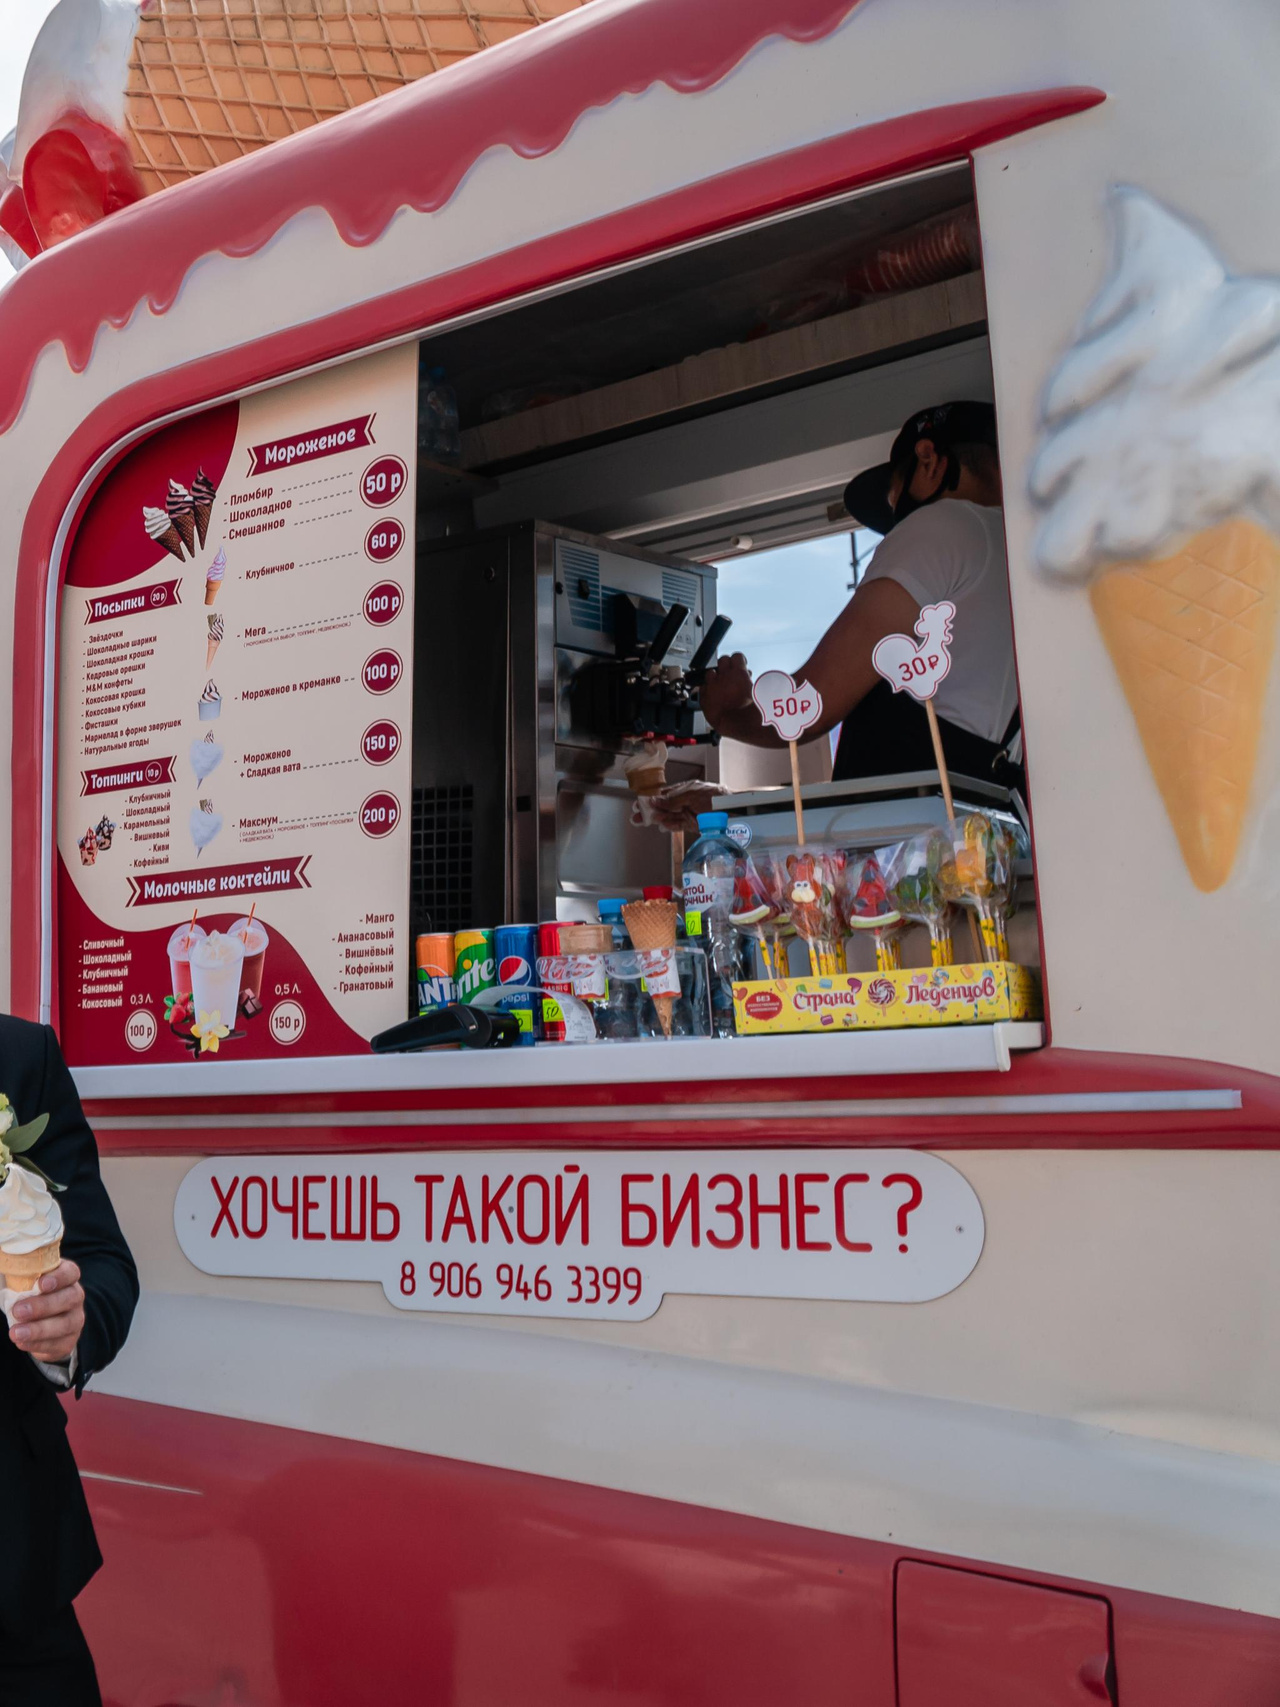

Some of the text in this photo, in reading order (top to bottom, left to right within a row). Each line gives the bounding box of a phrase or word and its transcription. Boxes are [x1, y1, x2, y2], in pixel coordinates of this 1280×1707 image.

[264, 426, 357, 465] Мороженое
[365, 475, 387, 495] 50
[230, 486, 274, 506] Пломбир
[229, 498, 293, 523] Шоколадное
[228, 517, 286, 540] Смешанное
[371, 532, 388, 550] 60
[245, 560, 295, 580] Клубничное
[152, 593, 160, 601] 20
[367, 595, 389, 613] 100
[94, 595, 145, 618] Посыпки
[89, 630, 124, 644] Звёздочки
[244, 626, 267, 639] Мега
[87, 635, 157, 657] Шоколадные шарики
[86, 648, 155, 669] Шоколадная крошка
[86, 663, 146, 681] Кедровые орешки
[365, 663, 388, 681] 100
[104, 678, 133, 690] конфеты
[241, 684, 291, 701] Мороженое
[299, 675, 341, 691] креманке
[85, 687, 146, 706] Кокосовая крошка
[85, 700, 146, 718] Кокосовые кубики
[84, 718, 119, 731] Фисташки
[84, 730, 119, 744] Мармелад
[124, 726, 147, 738] форме
[148, 719, 182, 733] зверушек
[84, 737, 150, 756] Натуральные ягоды
[365, 735, 386, 751] 150
[243, 749, 292, 766] Мороженое
[147, 769, 154, 779] 10
[246, 763, 281, 779] Сладкая
[282, 761, 301, 774] вата
[90, 771, 144, 791] Топпинги
[128, 789, 171, 805] Клубничный
[125, 803, 171, 818] Шоколадный
[363, 808, 386, 825] 200
[123, 816, 171, 831] Карамельный
[239, 816, 279, 829] Максмум
[133, 829, 170, 843] Вишневый
[152, 843, 170, 853] Киви
[133, 855, 170, 869] Кофейный
[144, 865, 291, 900] Молочные коктейли
[365, 912, 395, 926] Манго
[83, 935, 125, 950] Сливочный
[337, 928, 395, 944] Ананасовый
[83, 949, 132, 965] Шоколадный
[344, 944, 395, 959] Вишнёвый
[82, 964, 129, 980] Клубничный
[344, 961, 395, 976] Кофейный
[82, 980, 124, 995] Банановый
[338, 978, 394, 994] Гранатовый
[793, 976, 996, 1012] Страна Леденцов
[81, 995, 123, 1010] Кокосовый
[129, 1025, 145, 1037] 100
[274, 1017, 291, 1030] 150
[210, 1164, 925, 1255] ХОЧЕШЬ ТАКОЙ БИЗНЕС?
[399, 1261, 644, 1306] 8 906 946 3399
